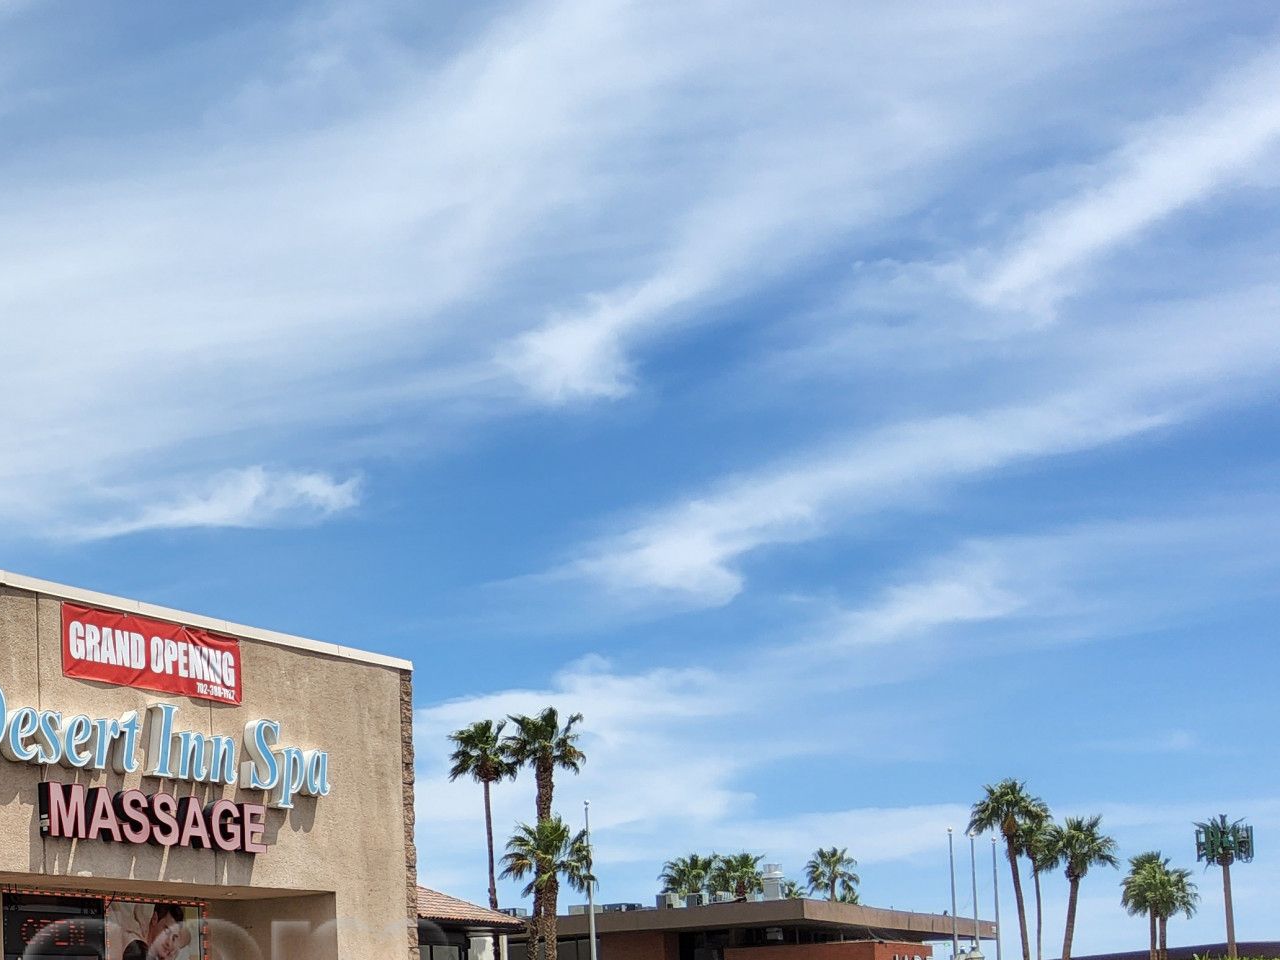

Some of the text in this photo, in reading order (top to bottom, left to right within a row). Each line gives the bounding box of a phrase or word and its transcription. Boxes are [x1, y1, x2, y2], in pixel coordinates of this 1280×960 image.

[69, 621, 236, 687] GRAND OPENING
[146, 703, 237, 785] Inn
[243, 719, 331, 809] Spa
[43, 781, 268, 853] MASSAGE
